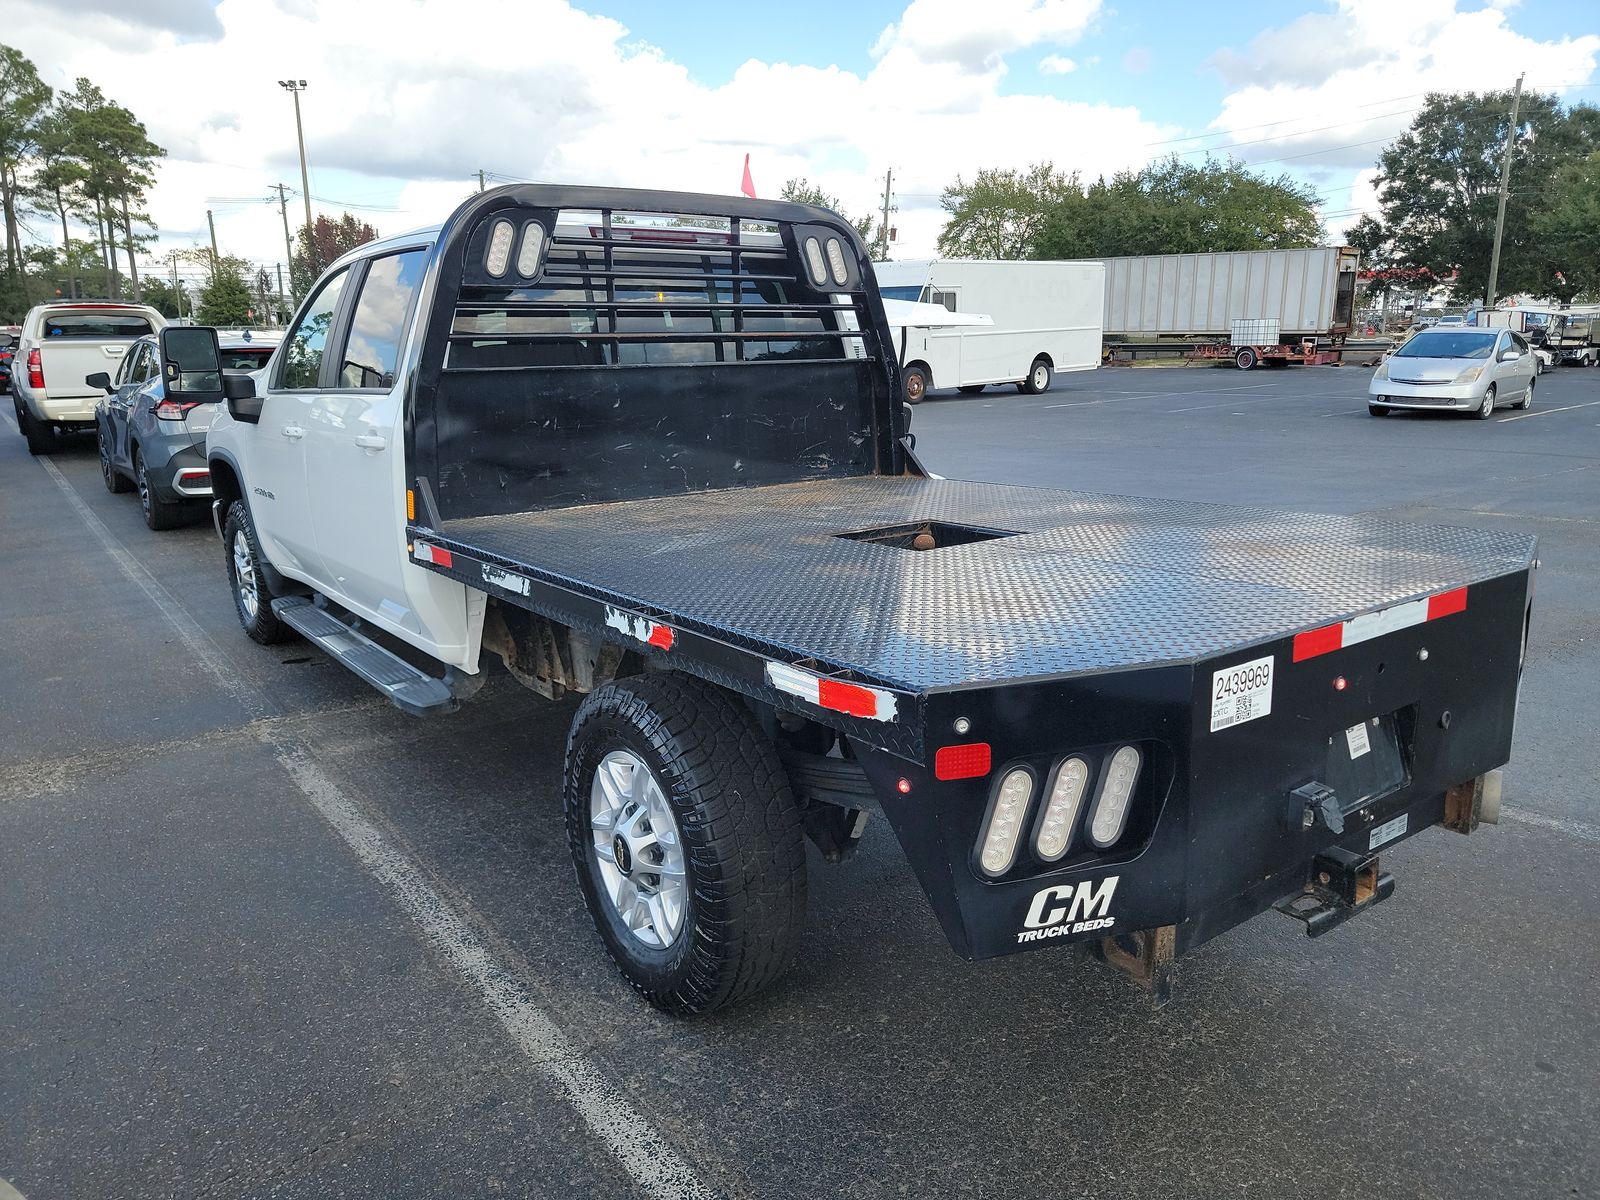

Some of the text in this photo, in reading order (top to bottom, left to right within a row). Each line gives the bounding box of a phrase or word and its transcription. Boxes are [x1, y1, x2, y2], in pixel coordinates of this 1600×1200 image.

[1216, 664, 1269, 700] 2439969
[1024, 875, 1120, 928] CM
[1017, 916, 1116, 943] TRUCK BEDS
